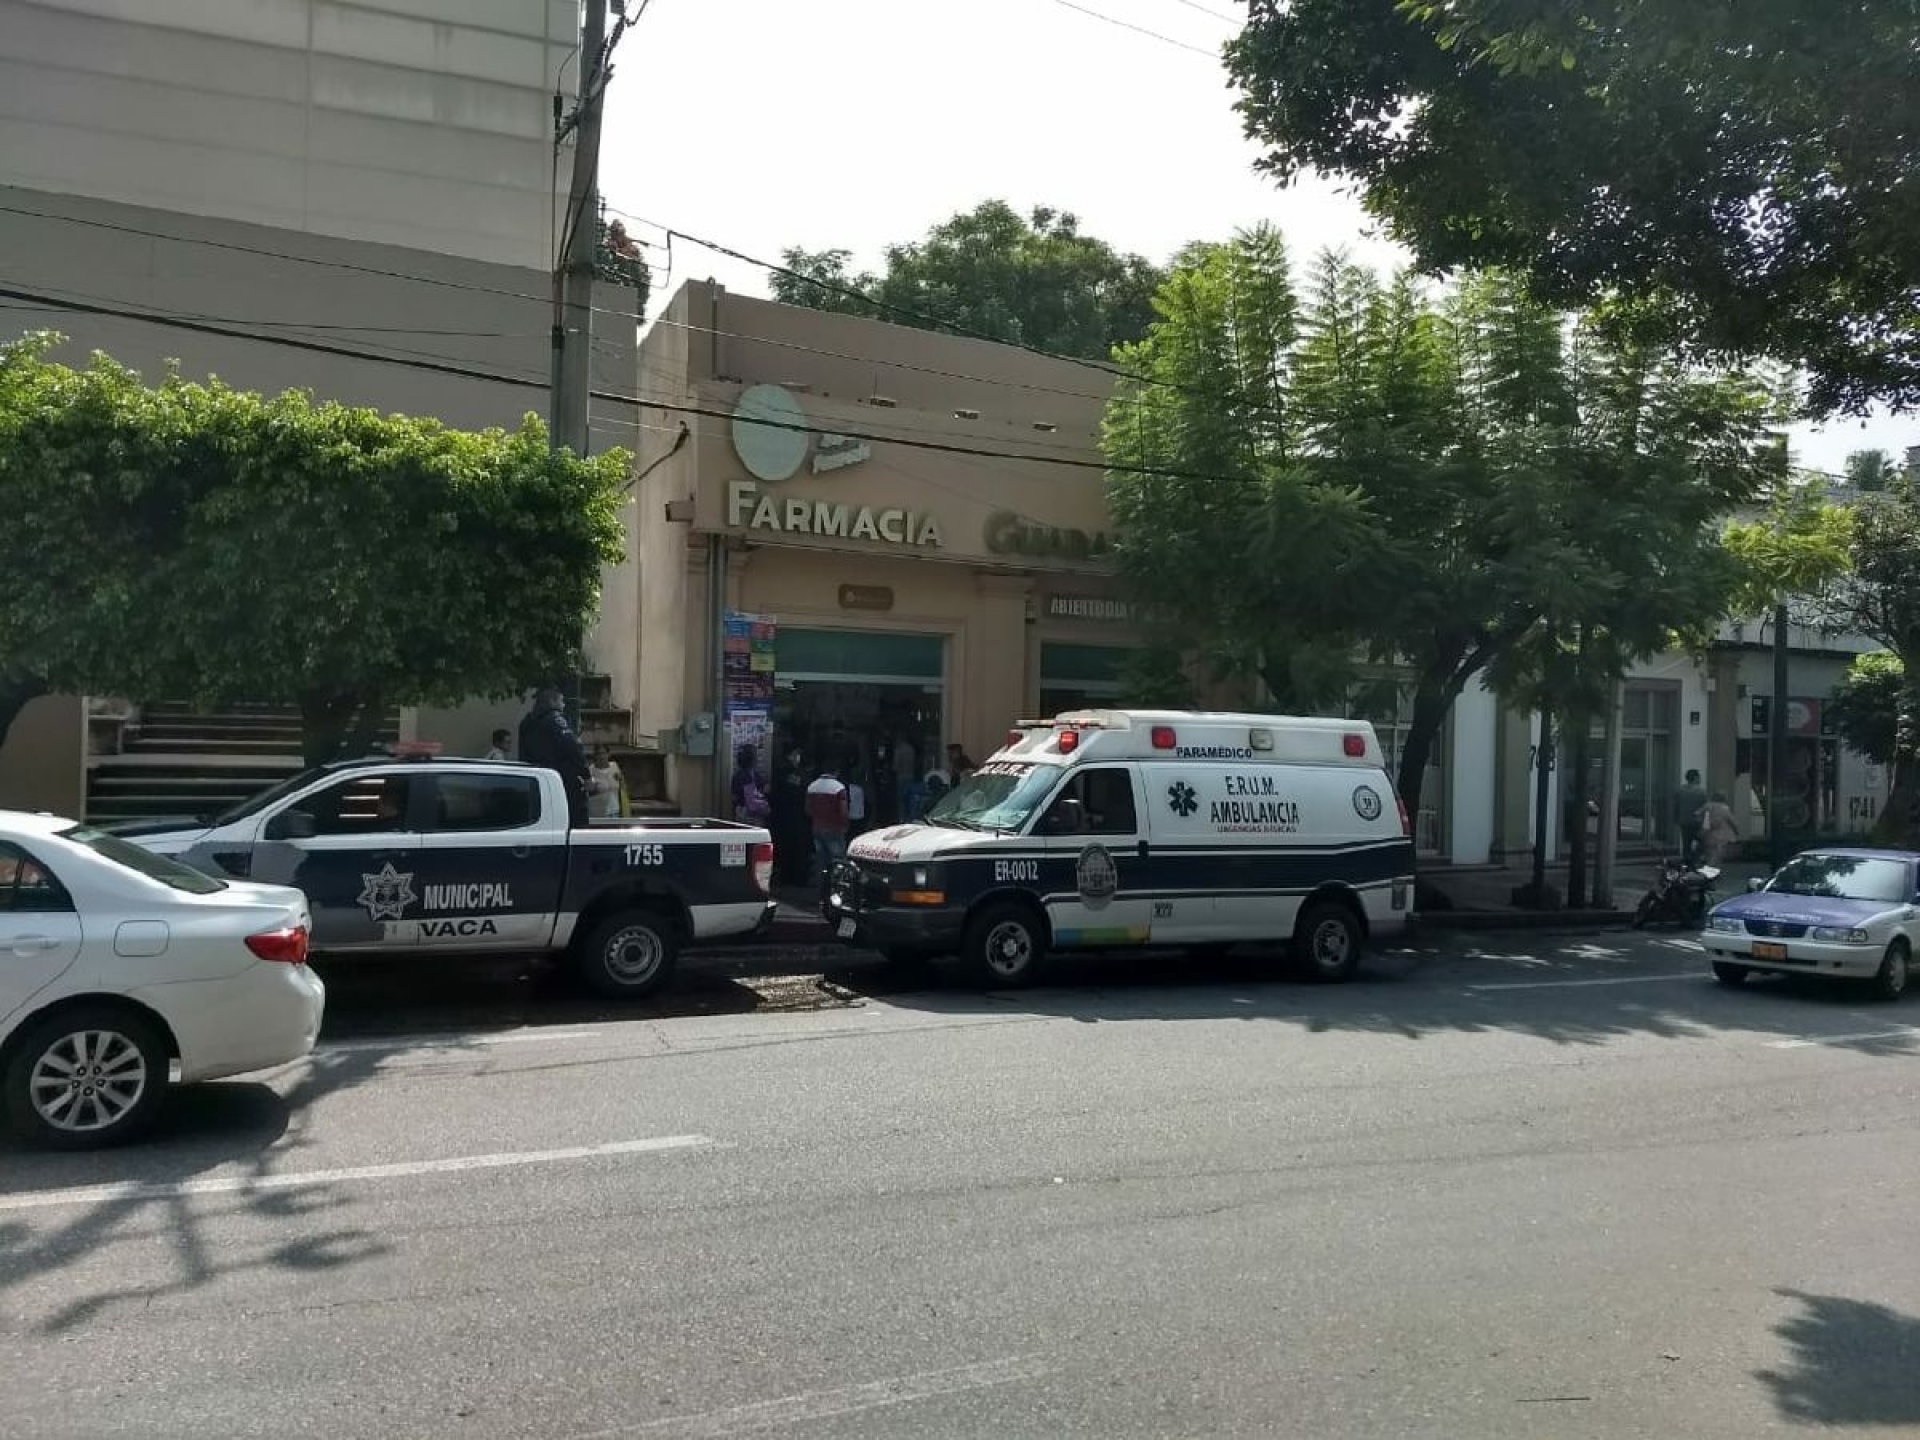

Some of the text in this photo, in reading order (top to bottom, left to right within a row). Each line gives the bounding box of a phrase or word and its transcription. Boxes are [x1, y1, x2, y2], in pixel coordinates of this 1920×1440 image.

[728, 480, 943, 547] FARMACIA
[1225, 775, 1279, 796] E.R.U.M.
[1210, 801, 1300, 825] AMBULANCIA
[623, 844, 664, 865] 1755
[994, 860, 1039, 881] ER-0012
[423, 882, 513, 909] MUNICIPAL
[420, 918, 497, 937] VACA
